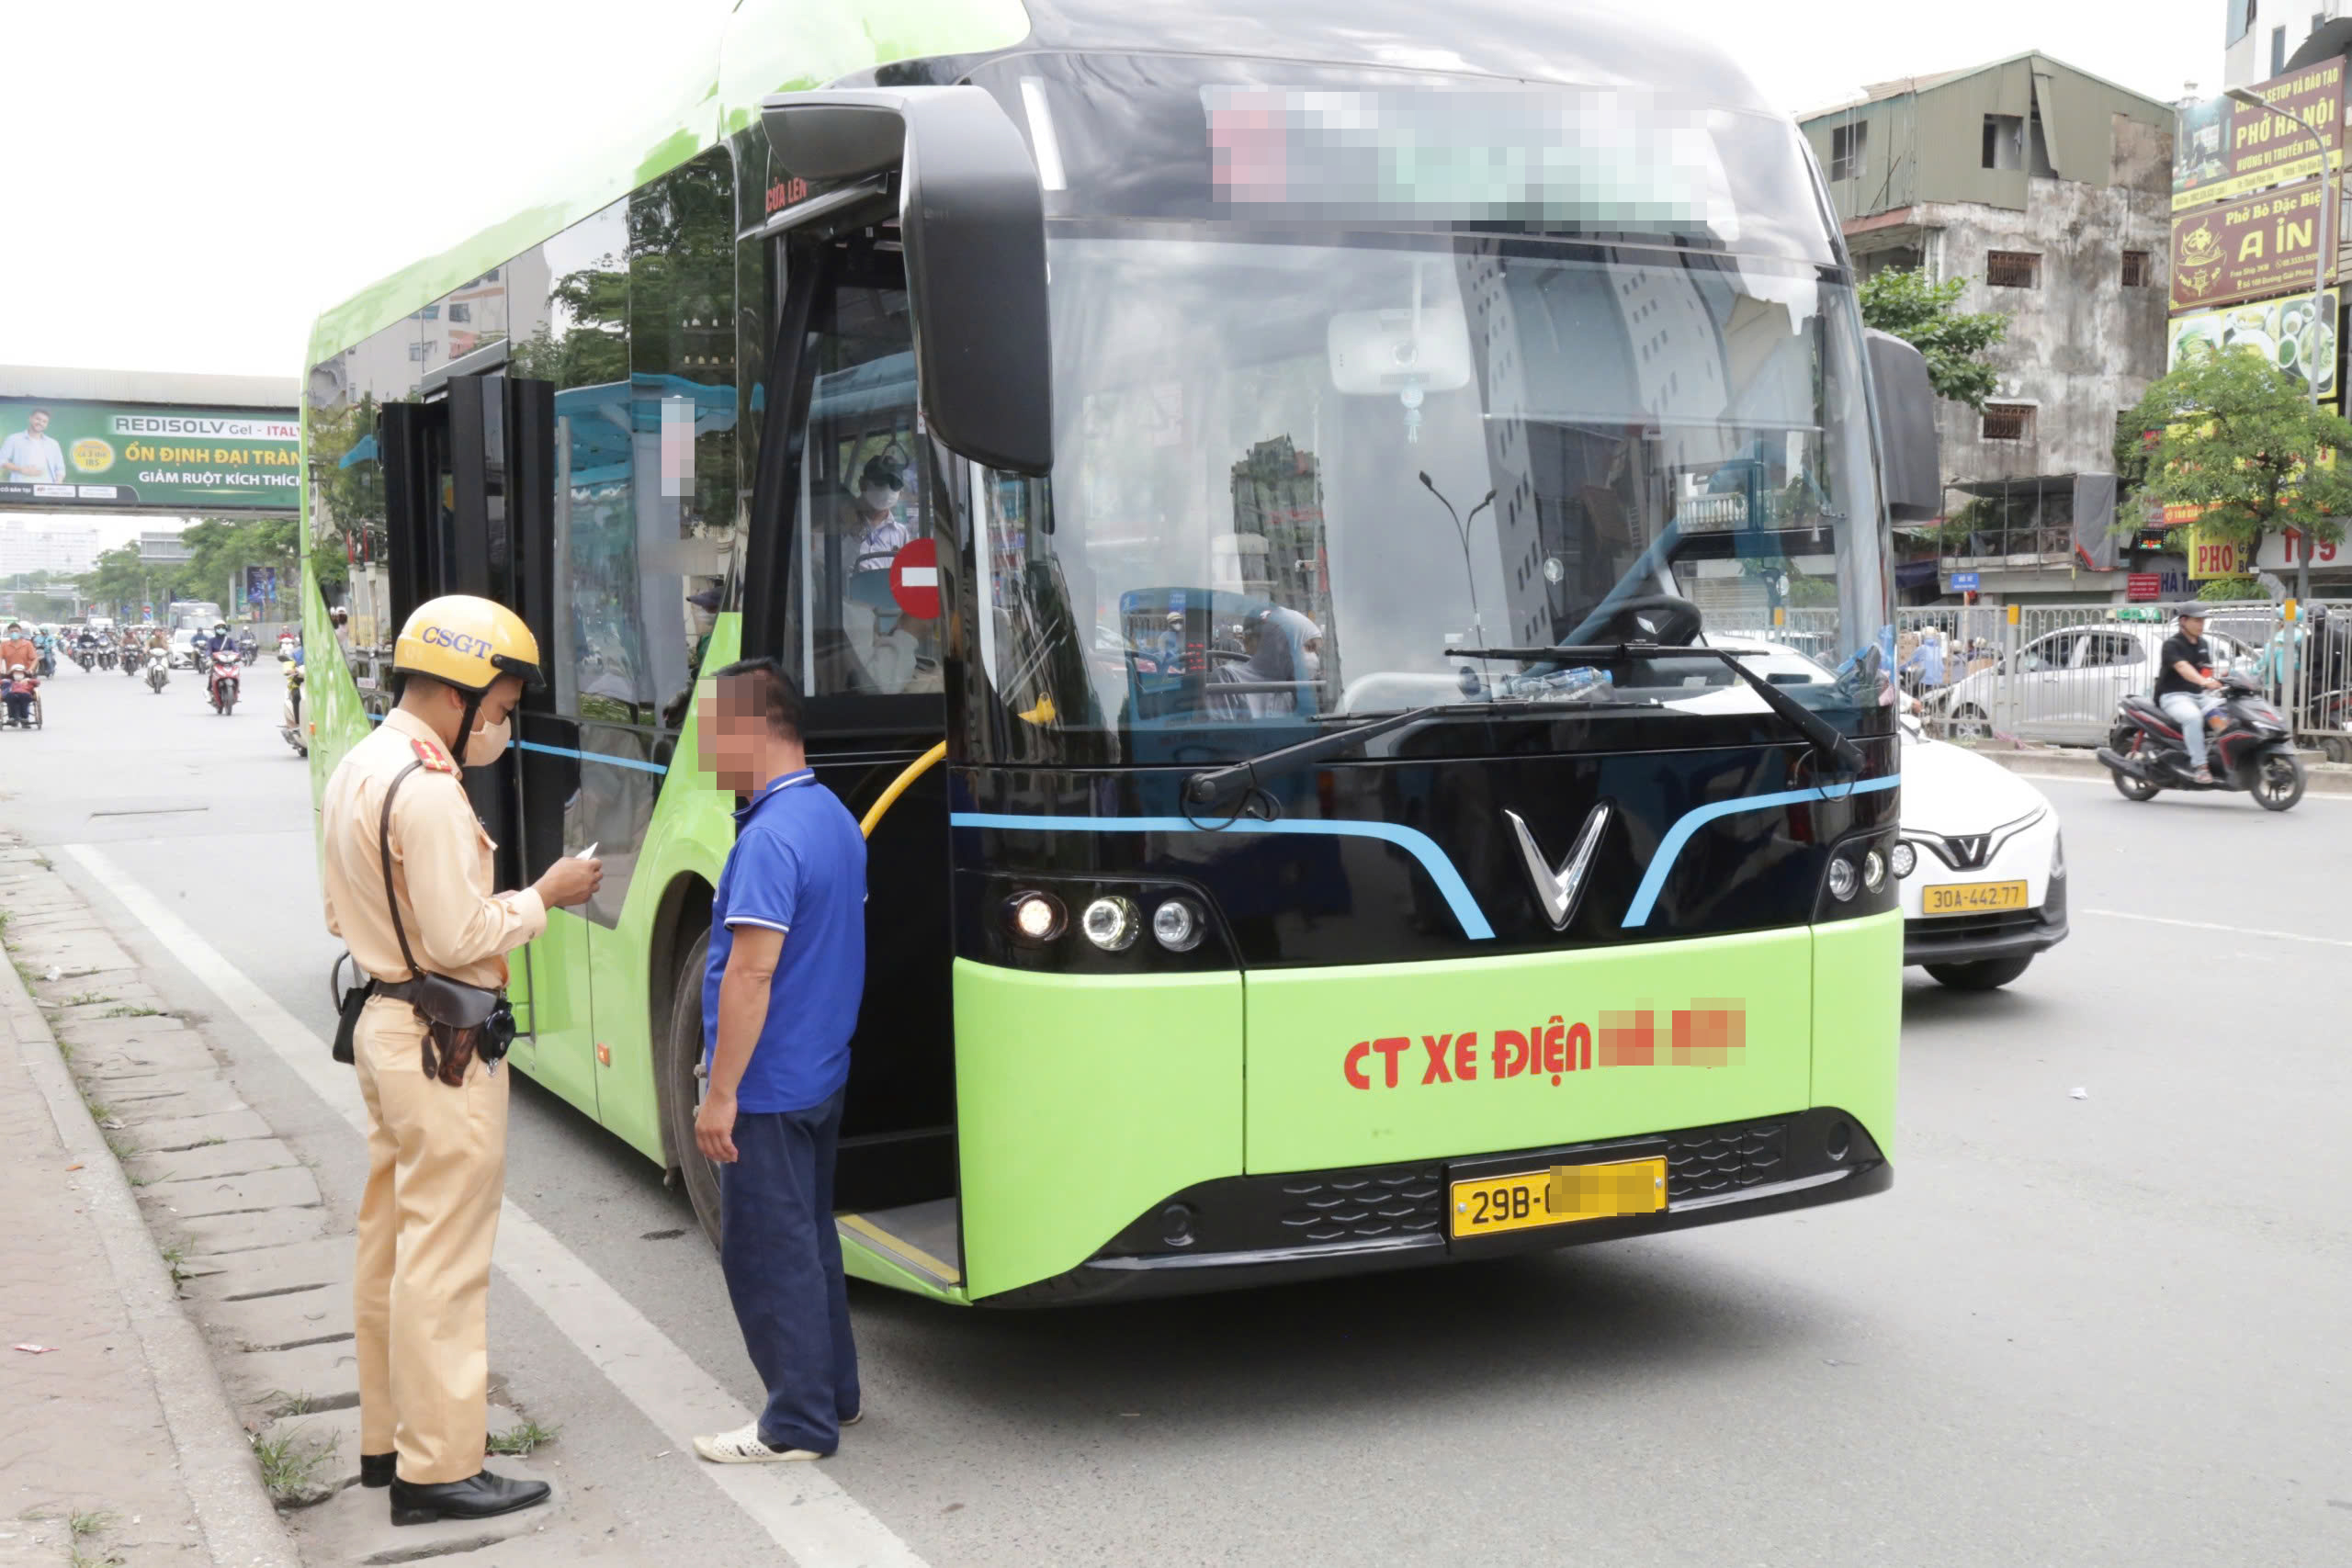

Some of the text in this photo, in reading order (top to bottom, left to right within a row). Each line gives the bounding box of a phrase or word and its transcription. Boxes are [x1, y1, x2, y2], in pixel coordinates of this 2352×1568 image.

[2266, 83, 2291, 103] SETUP
[2323, 67, 2338, 88] TẠO
[2236, 96, 2335, 149] PHỞ HÀ NỘI
[2225, 189, 2323, 226] Phở Bò Đặc Biệ
[2238, 217, 2313, 263] A ỈN
[115, 417, 225, 435] REDISOLV
[229, 423, 252, 435] Gel
[125, 441, 154, 462] ỔN
[159, 447, 209, 468] ĐỊNH
[214, 448, 249, 468] ĐẠI
[139, 470, 179, 484] GIẢM
[182, 472, 223, 488] RUỘT
[225, 471, 260, 486] KÍCH
[422, 626, 492, 660] CSGT
[1933, 886, 2019, 908] 30A-442.77
[1343, 1036, 1411, 1090] CT
[1420, 1032, 1477, 1086] XE
[1471, 1184, 1551, 1225] 29B-
